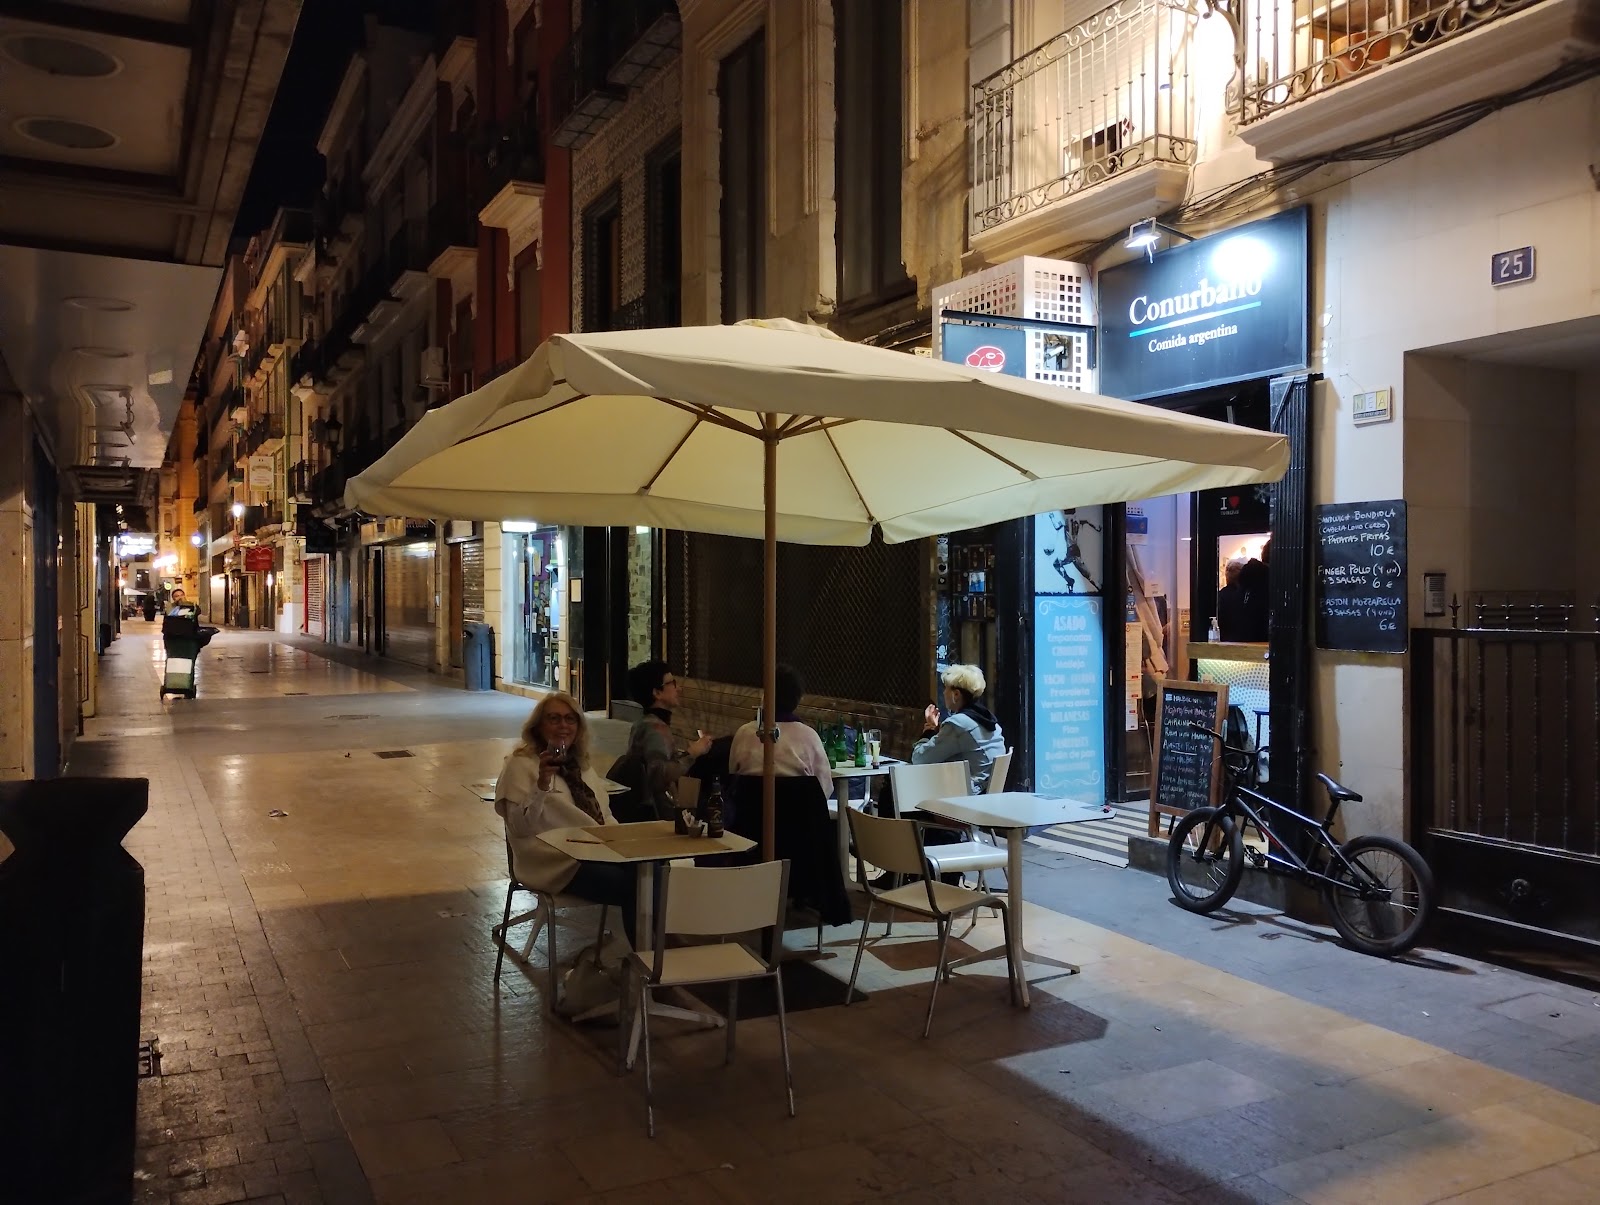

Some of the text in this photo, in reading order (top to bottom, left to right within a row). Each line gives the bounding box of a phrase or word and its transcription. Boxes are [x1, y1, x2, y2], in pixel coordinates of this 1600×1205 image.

[1500, 253, 1523, 278] 25
[1129, 277, 1263, 325] Conurbano
[1148, 323, 1238, 353] Comida argentina
[1220, 496, 1228, 511] I
[1354, 508, 1396, 520] BONDIOLA
[1327, 534, 1359, 546] PATATAS
[1360, 531, 1391, 543] FRITAS
[1370, 543, 1395, 557] 10 €
[1317, 565, 1346, 576] FINGER
[1347, 562, 1371, 576] POLLO
[1372, 576, 1381, 589] 6
[1385, 580, 1393, 589] €
[1352, 596, 1401, 607] MOZZARELLA
[1053, 615, 1087, 631] ASADO
